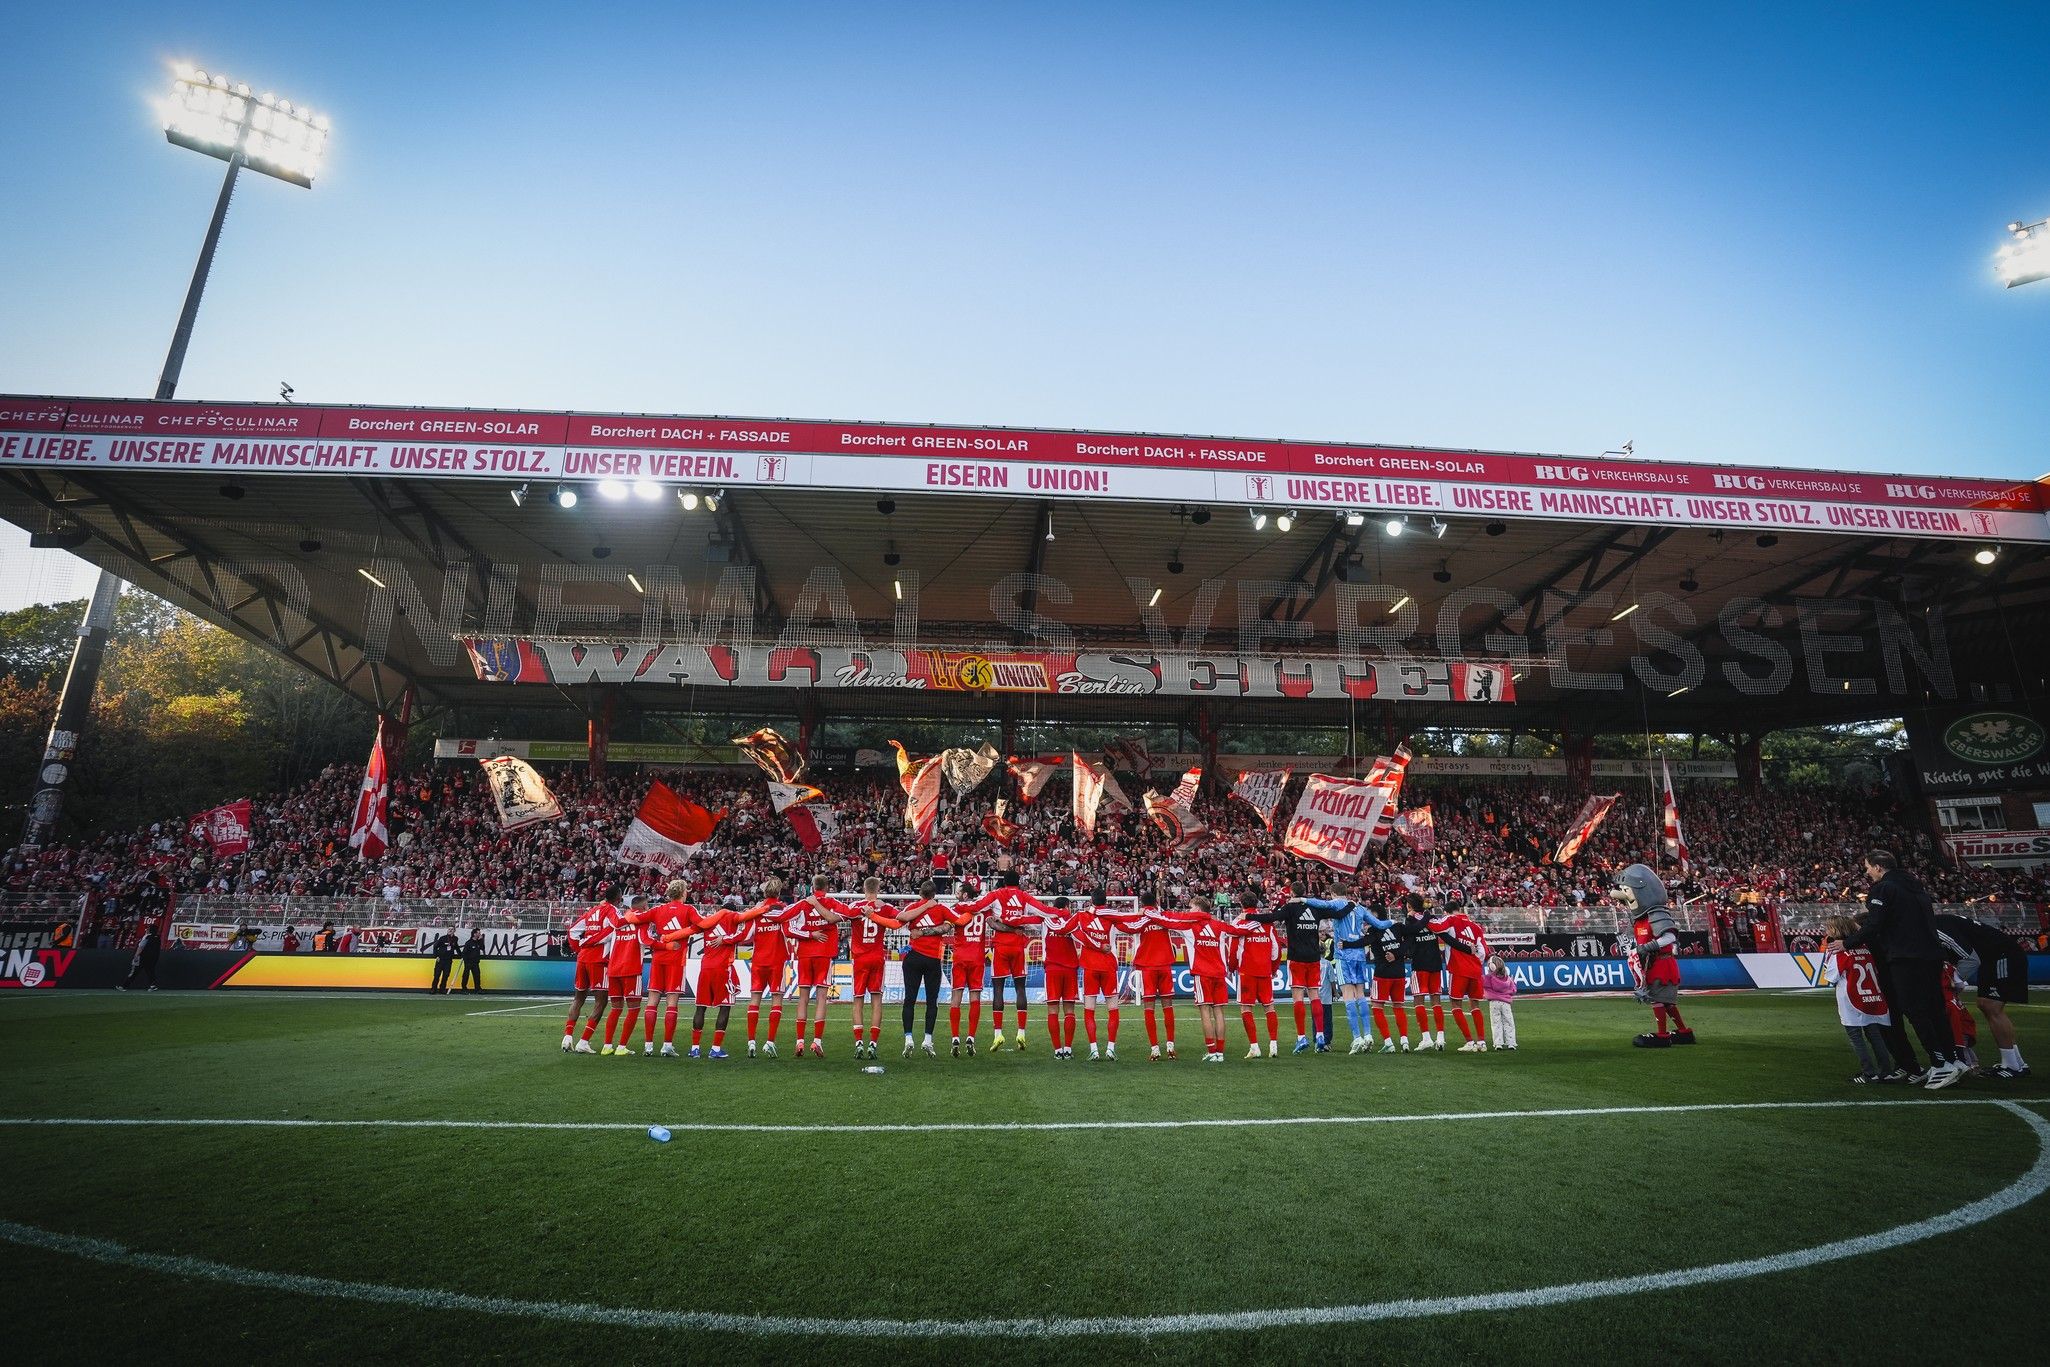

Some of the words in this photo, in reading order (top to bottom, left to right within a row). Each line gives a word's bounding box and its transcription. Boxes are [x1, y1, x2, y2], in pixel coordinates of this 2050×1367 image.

[348, 419, 415, 433] Borchert
[420, 422, 540, 436] GREEN-SOLAR
[590, 425, 656, 439] Borchert
[661, 428, 702, 441] DACH
[707, 432, 716, 440] +
[720, 430, 790, 443] FASSADE
[841, 434, 906, 447] Borchert
[912, 436, 1029, 451] GREEN-SOLAR
[1076, 443, 1140, 456] Borchert
[1144, 446, 1184, 459] DACH
[1188, 451, 1196, 459] +
[1200, 449, 1267, 463] FASSADE
[22, 438, 97, 462] LIEBE.
[109, 441, 205, 464] UNSERE
[211, 443, 379, 470] MANNSCHAFT.
[389, 446, 468, 472] UNSER
[473, 450, 550, 474] STOLZ.
[565, 452, 642, 477] UNSER
[649, 454, 740, 479] VEREIN.
[1315, 453, 1375, 467] Borchert
[1379, 458, 1485, 474] GREEN-SOLAR
[926, 463, 1008, 488] EISERN
[1028, 468, 1109, 492] UNION!
[1534, 465, 1589, 482] BUG
[1592, 470, 1673, 484] VERKEHRSBAU
[1674, 474, 1690, 485] SE
[1712, 474, 1765, 491] BUG
[1768, 479, 1847, 493] VERKEHRSBAU
[1848, 485, 1862, 495] SE
[1885, 483, 1937, 500] BUG
[1938, 489, 2016, 502] VERKEHRSBAU
[2017, 493, 2031, 503] SE
[1287, 479, 1370, 503] UNSERE
[1375, 483, 1440, 507] LIEBE.
[1453, 487, 1533, 512] UNSERE
[1540, 492, 1680, 518] MANNSCHAFT.
[1687, 499, 1751, 522] UNSER
[1756, 503, 1820, 526] STOLZ.
[1826, 507, 1889, 530] UNSER
[1890, 510, 1968, 534] VEREIN.
[536, 642, 908, 688] WALD
[1075, 654, 1452, 702] SEITE
[834, 664, 927, 690] Union
[992, 661, 1049, 689] UNION
[1056, 671, 1145, 697] Berlin
[1950, 732, 2041, 759] EBERSWALDER
[1923, 770, 1973, 785] Richtig
[1978, 768, 2004, 785] gut
[2012, 765, 2033, 778] die
[143, 916, 156, 924] Tor
[862, 915, 879, 938] 15
[964, 914, 985, 937] 28
[1755, 923, 1767, 932] Tor
[1760, 934, 1766, 942] 2
[37, 949, 78, 978] TV
[1553, 962, 1626, 988] GMBH
[1853, 962, 1882, 996] 21
